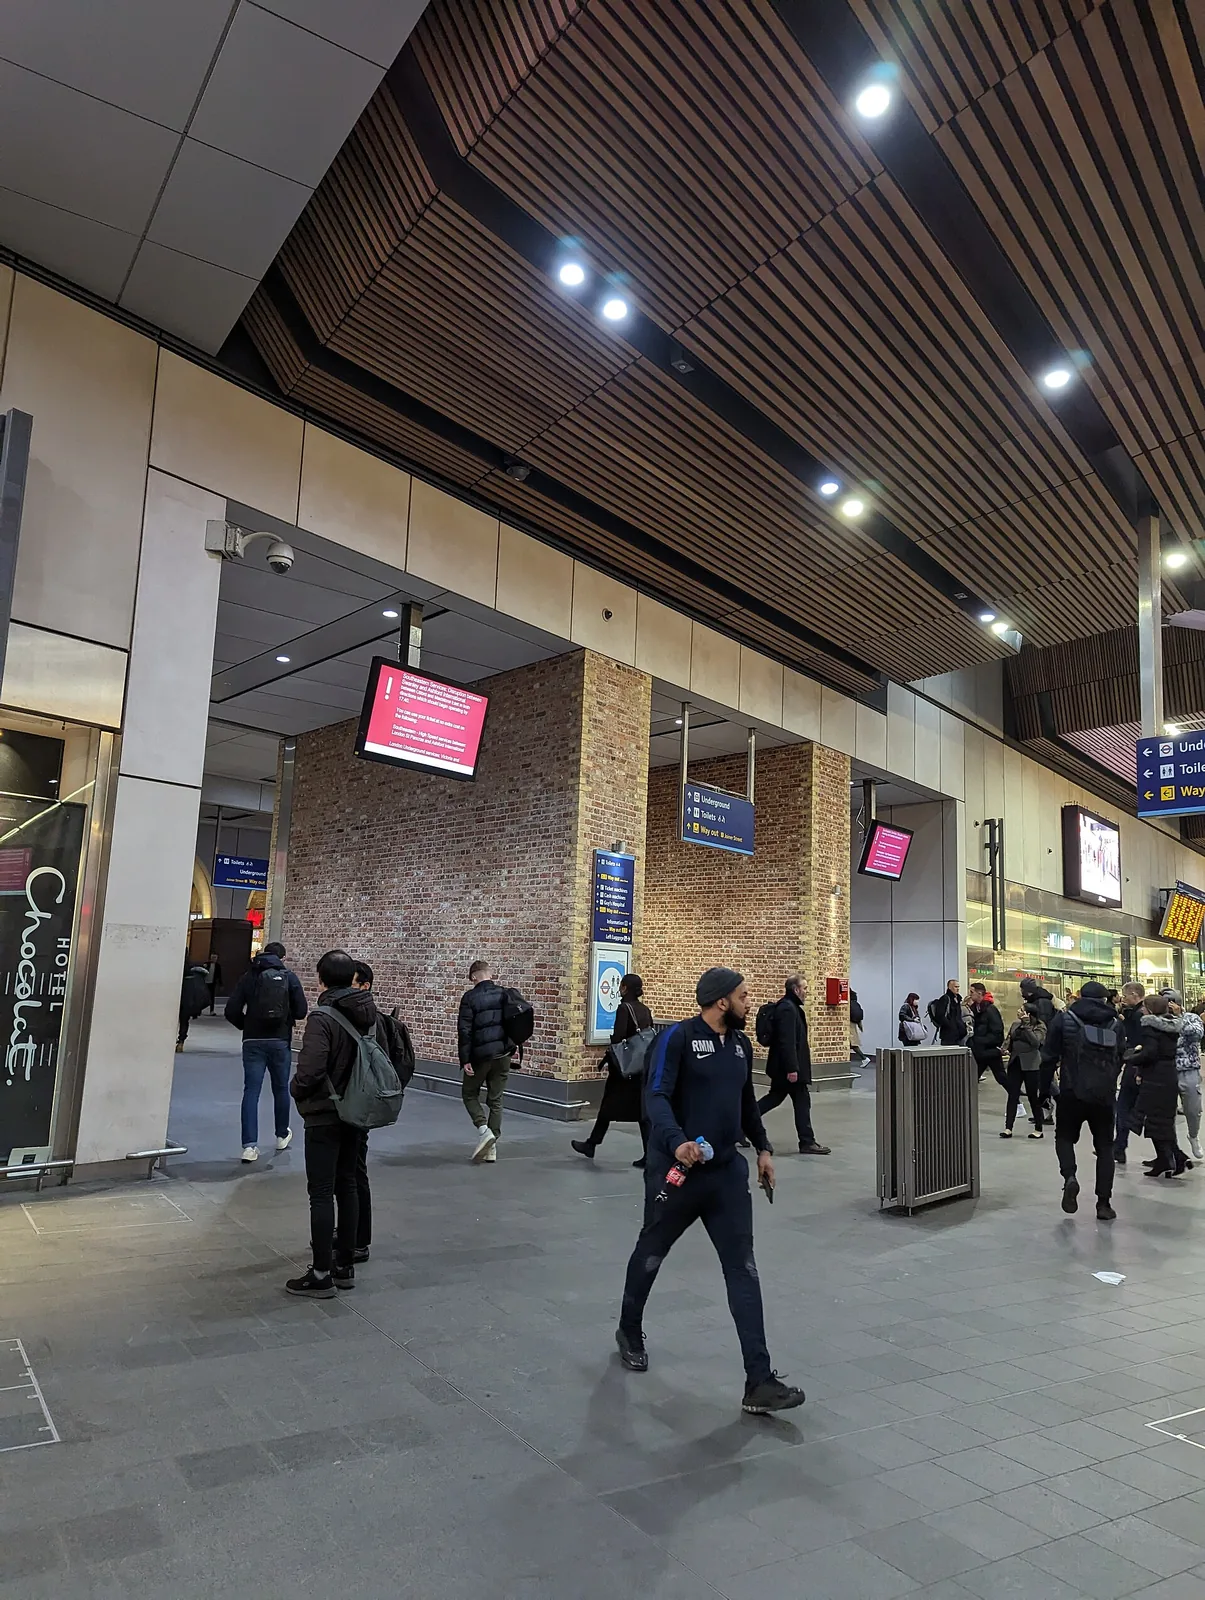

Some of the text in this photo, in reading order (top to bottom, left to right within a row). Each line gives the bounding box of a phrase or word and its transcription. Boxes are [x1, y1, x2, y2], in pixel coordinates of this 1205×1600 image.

[403, 674, 429, 686] Southeastern
[448, 688, 466, 698] Disruption
[467, 694, 482, 702] between
[1179, 739, 1205, 753] Und
[702, 796, 730, 810] Underground
[701, 810, 716, 821] Toilets
[701, 826, 710, 836] Way
[50, 937, 70, 1012] HOTEL
[692, 1039, 716, 1053] RMM
